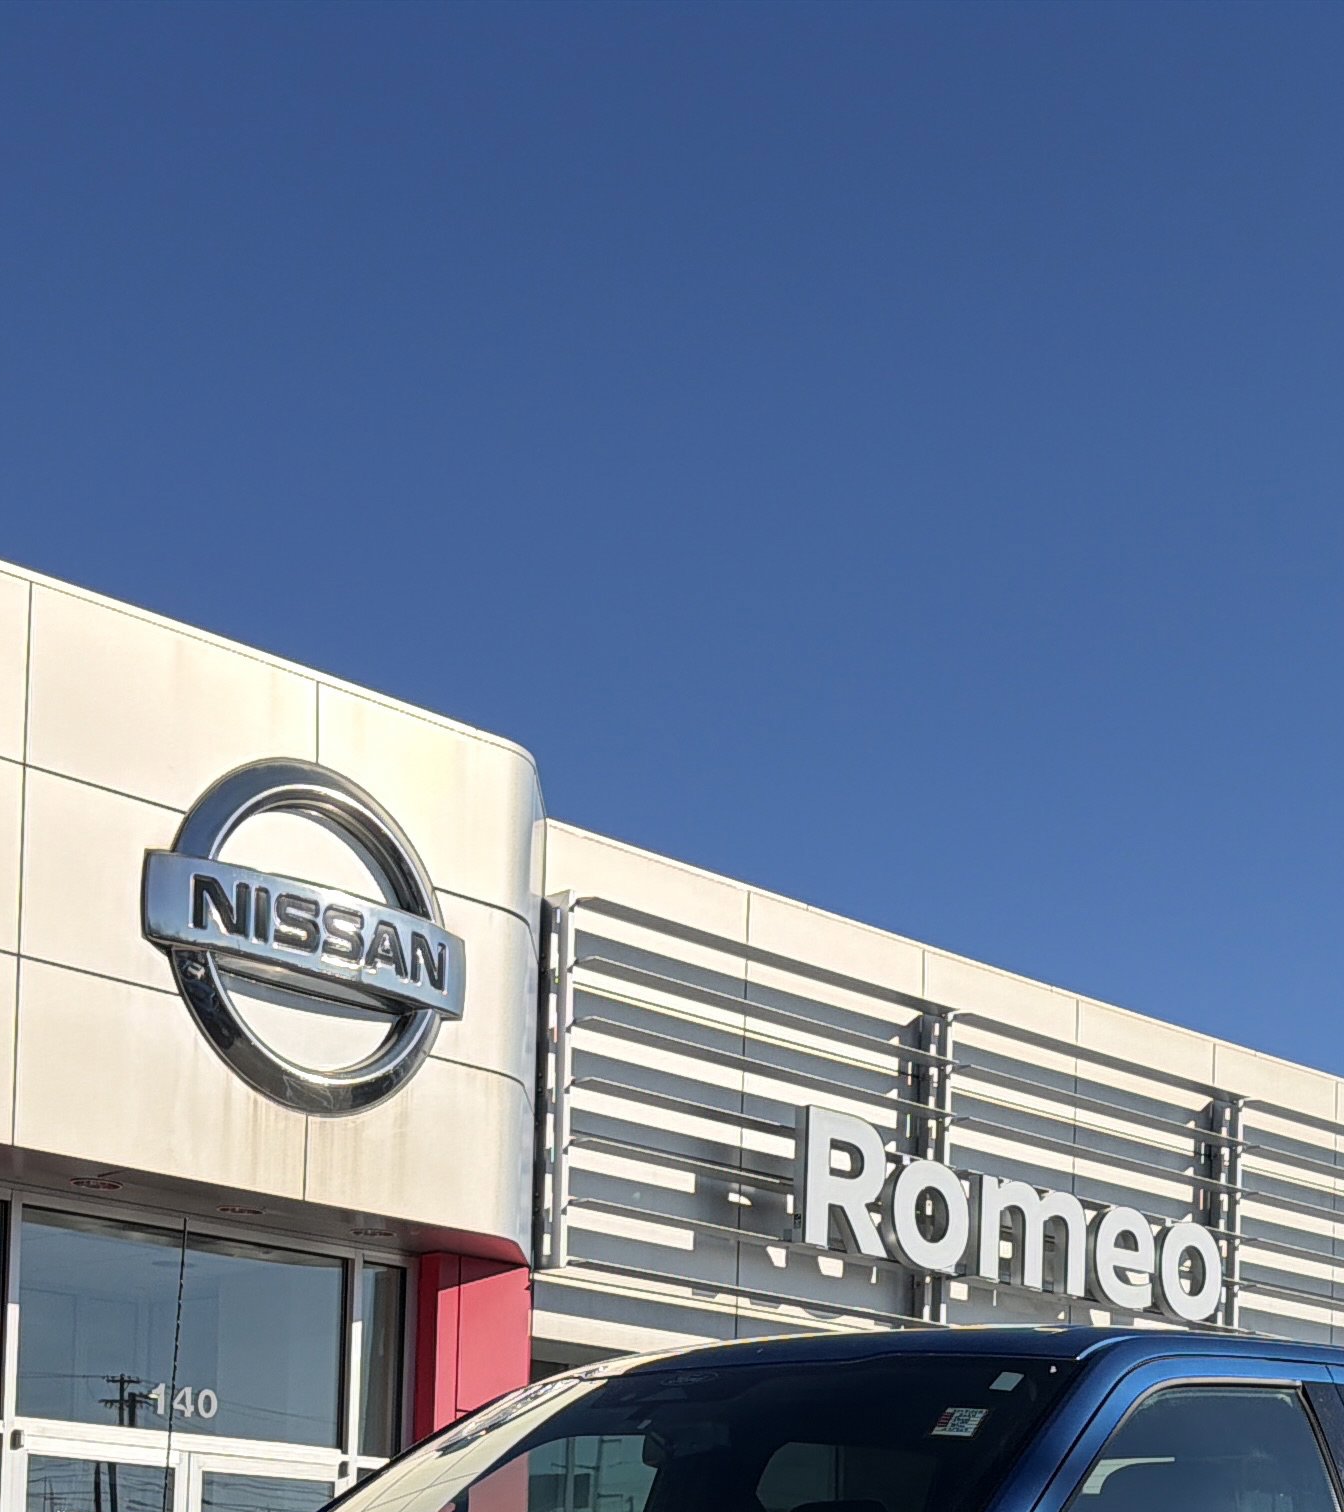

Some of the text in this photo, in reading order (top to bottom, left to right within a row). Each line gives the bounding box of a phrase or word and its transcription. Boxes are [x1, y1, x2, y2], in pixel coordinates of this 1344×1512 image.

[189, 873, 449, 995] NISSAN
[801, 1104, 1223, 1322] Romeo
[151, 1382, 218, 1419] 140
